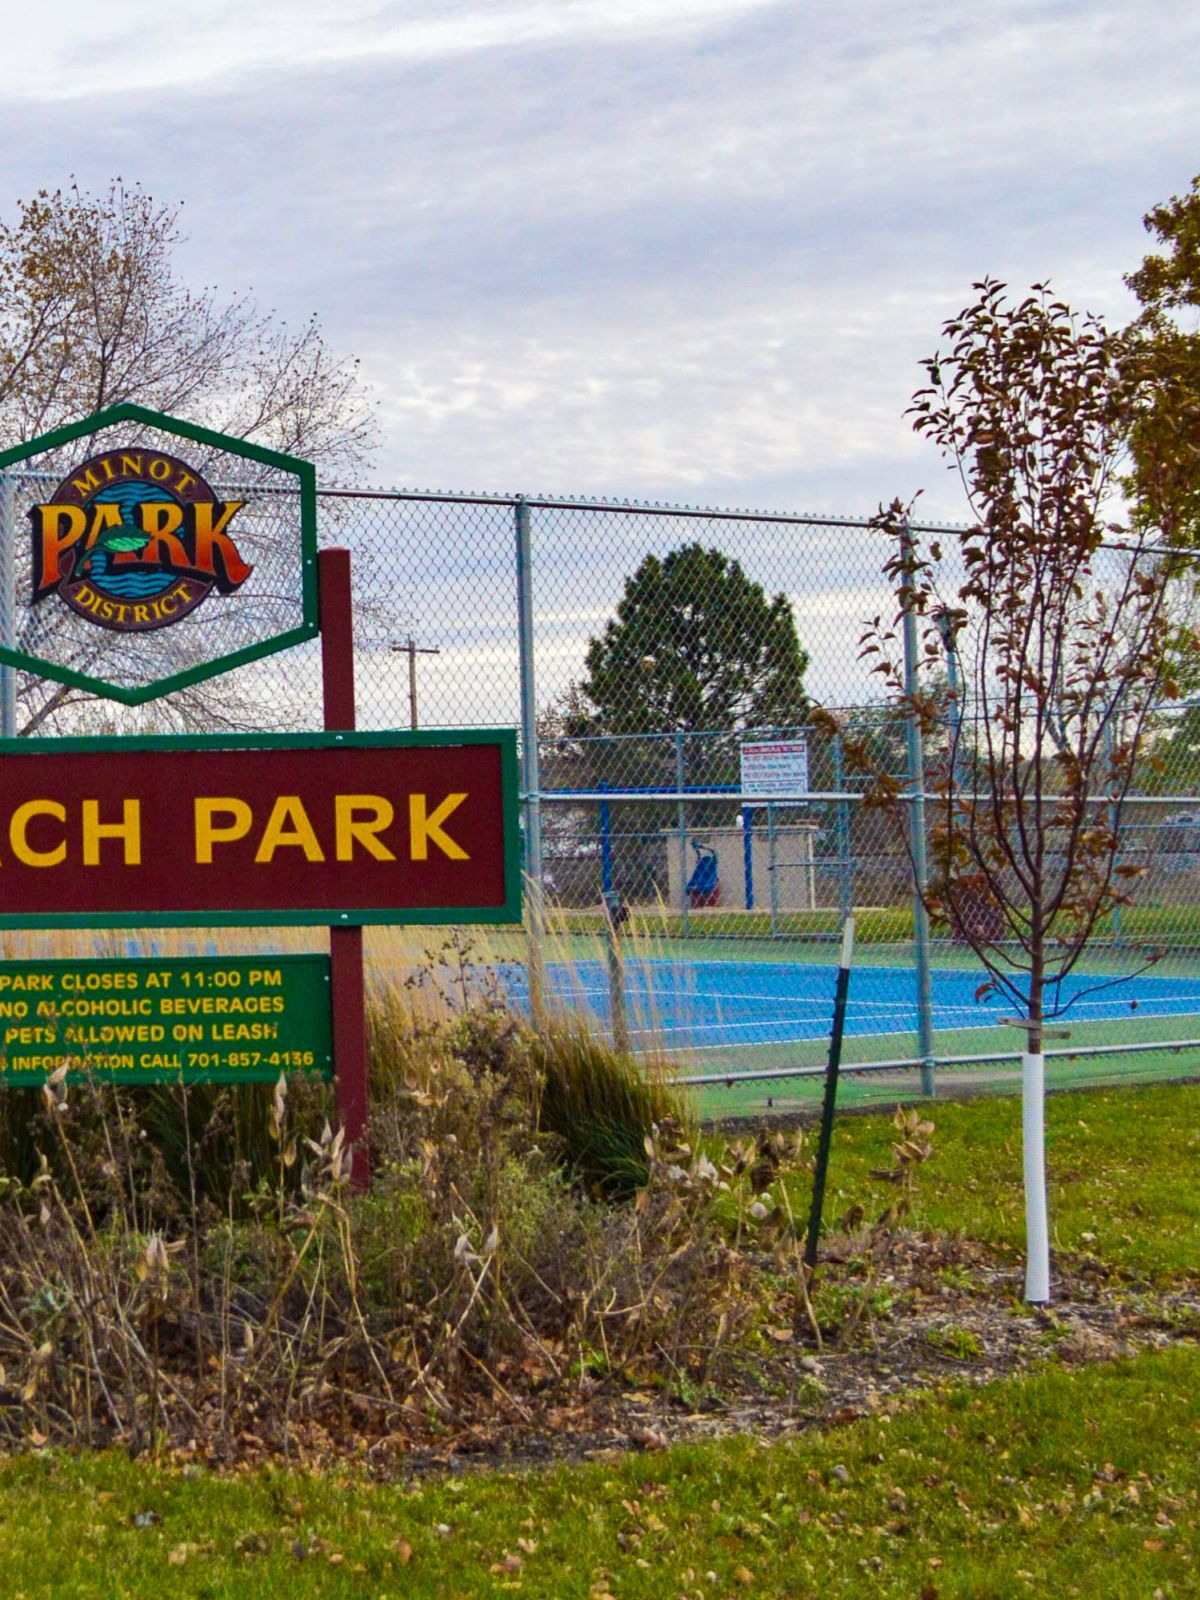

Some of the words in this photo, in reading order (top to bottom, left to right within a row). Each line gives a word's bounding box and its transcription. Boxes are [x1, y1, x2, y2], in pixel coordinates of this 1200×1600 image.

[71, 455, 198, 498] MINOT
[36, 500, 254, 594] PARK
[74, 583, 195, 624] DISTRICT
[194, 793, 471, 865] PARK
[61, 972, 138, 991] CLOSES
[145, 971, 172, 989] AT
[180, 970, 241, 988] 11:00
[249, 969, 282, 987] PM
[36, 998, 152, 1017] ALCOHOLIC
[160, 996, 284, 1015] BEVERAGES
[4, 1026, 56, 1044] PETS
[64, 1024, 165, 1043] ALLOWED
[173, 1023, 203, 1042] ON
[212, 1022, 278, 1041] LEASH
[140, 1053, 181, 1069] CALL
